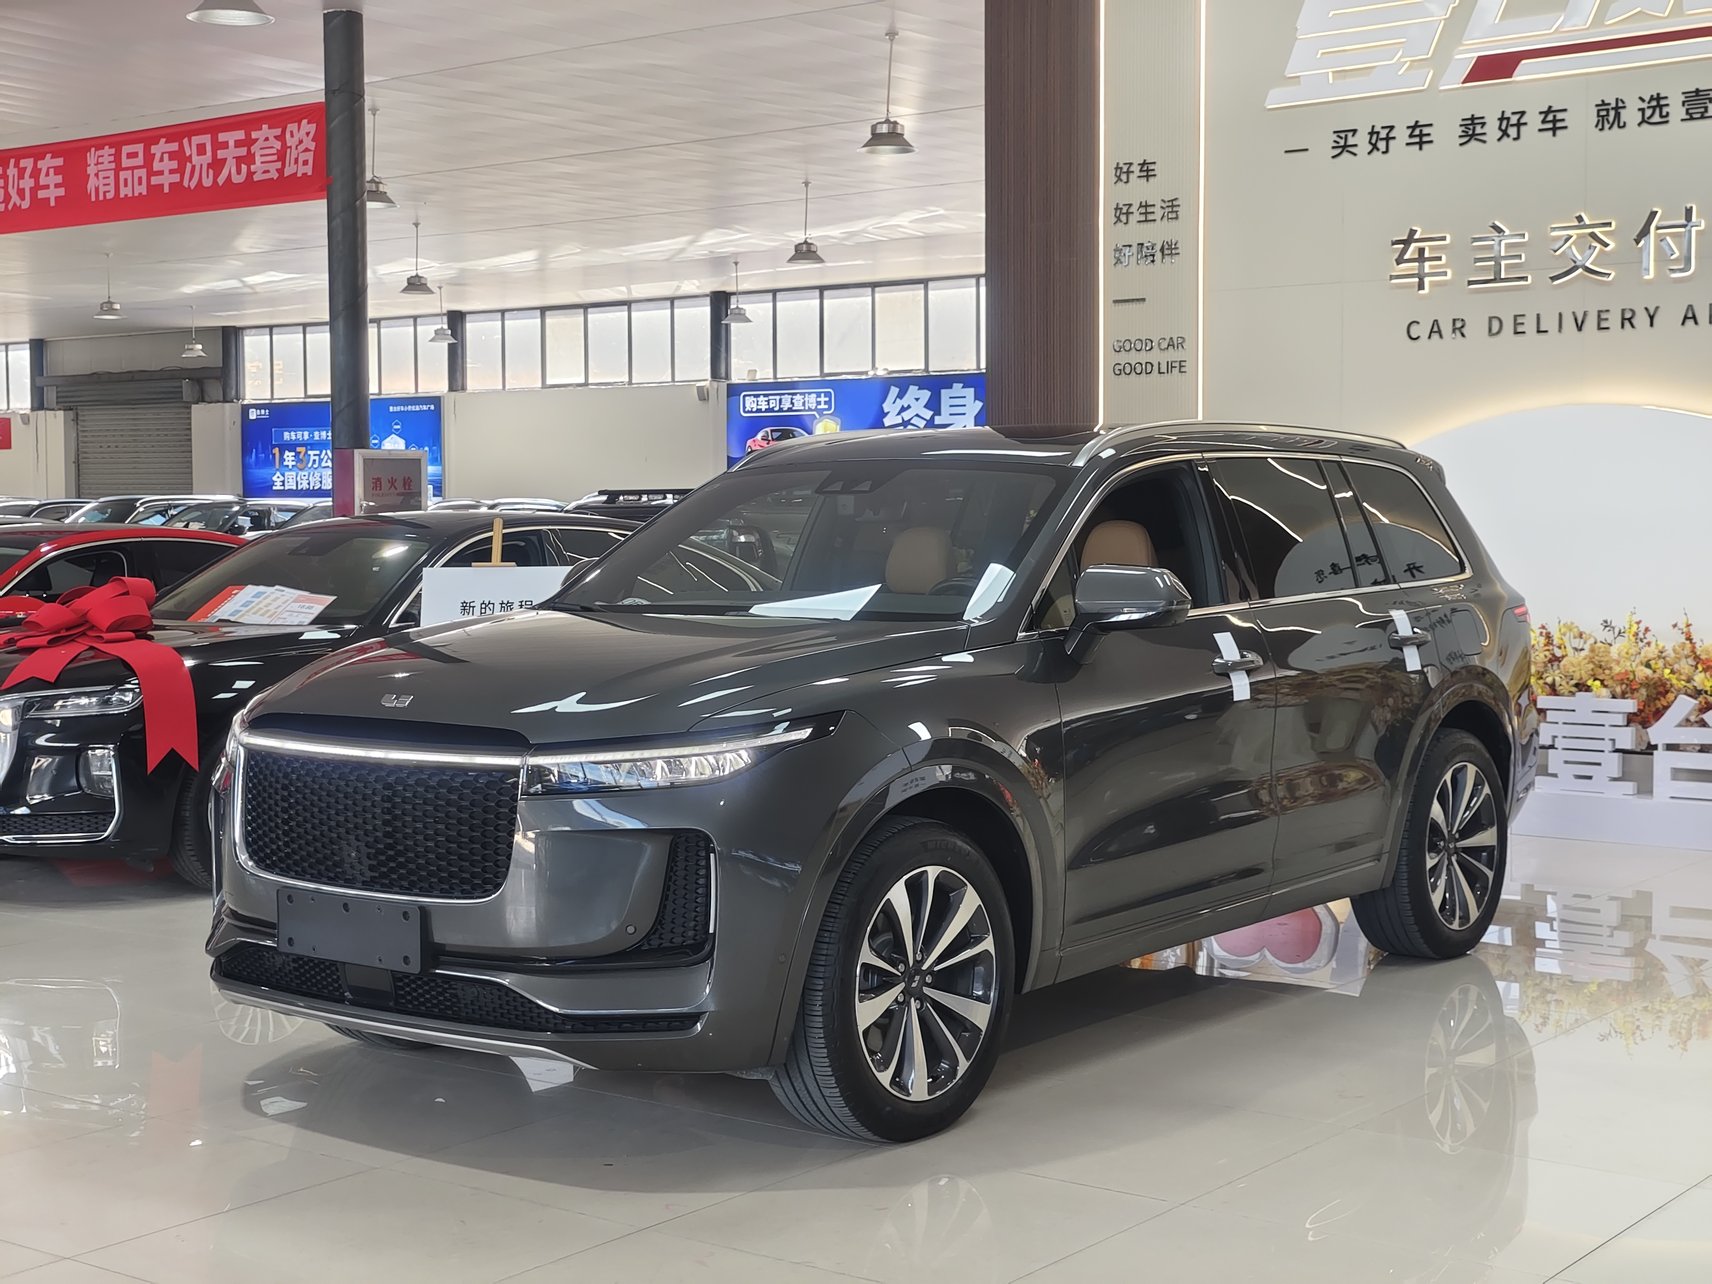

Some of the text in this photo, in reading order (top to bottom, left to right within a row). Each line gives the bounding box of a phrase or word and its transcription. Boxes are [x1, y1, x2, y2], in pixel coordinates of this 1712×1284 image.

[1330, 88, 1712, 159] 买好车 卖好车 就选壹
[0, 118, 318, 212] 好车 精品车况无套路
[1113, 159, 1157, 185] 好车
[1113, 197, 1181, 226] 好生活
[1113, 239, 1181, 266] 好陪伴
[1389, 204, 1704, 294] 车主交付
[1405, 302, 1712, 341] CAR DELIVERY A
[1112, 336, 1186, 353] GOOD CAR
[1112, 360, 1187, 376] GOOD LIFE
[744, 392, 830, 412] 购车可享查博士
[882, 382, 984, 430] 终身
[371, 476, 413, 491] 消火栓
